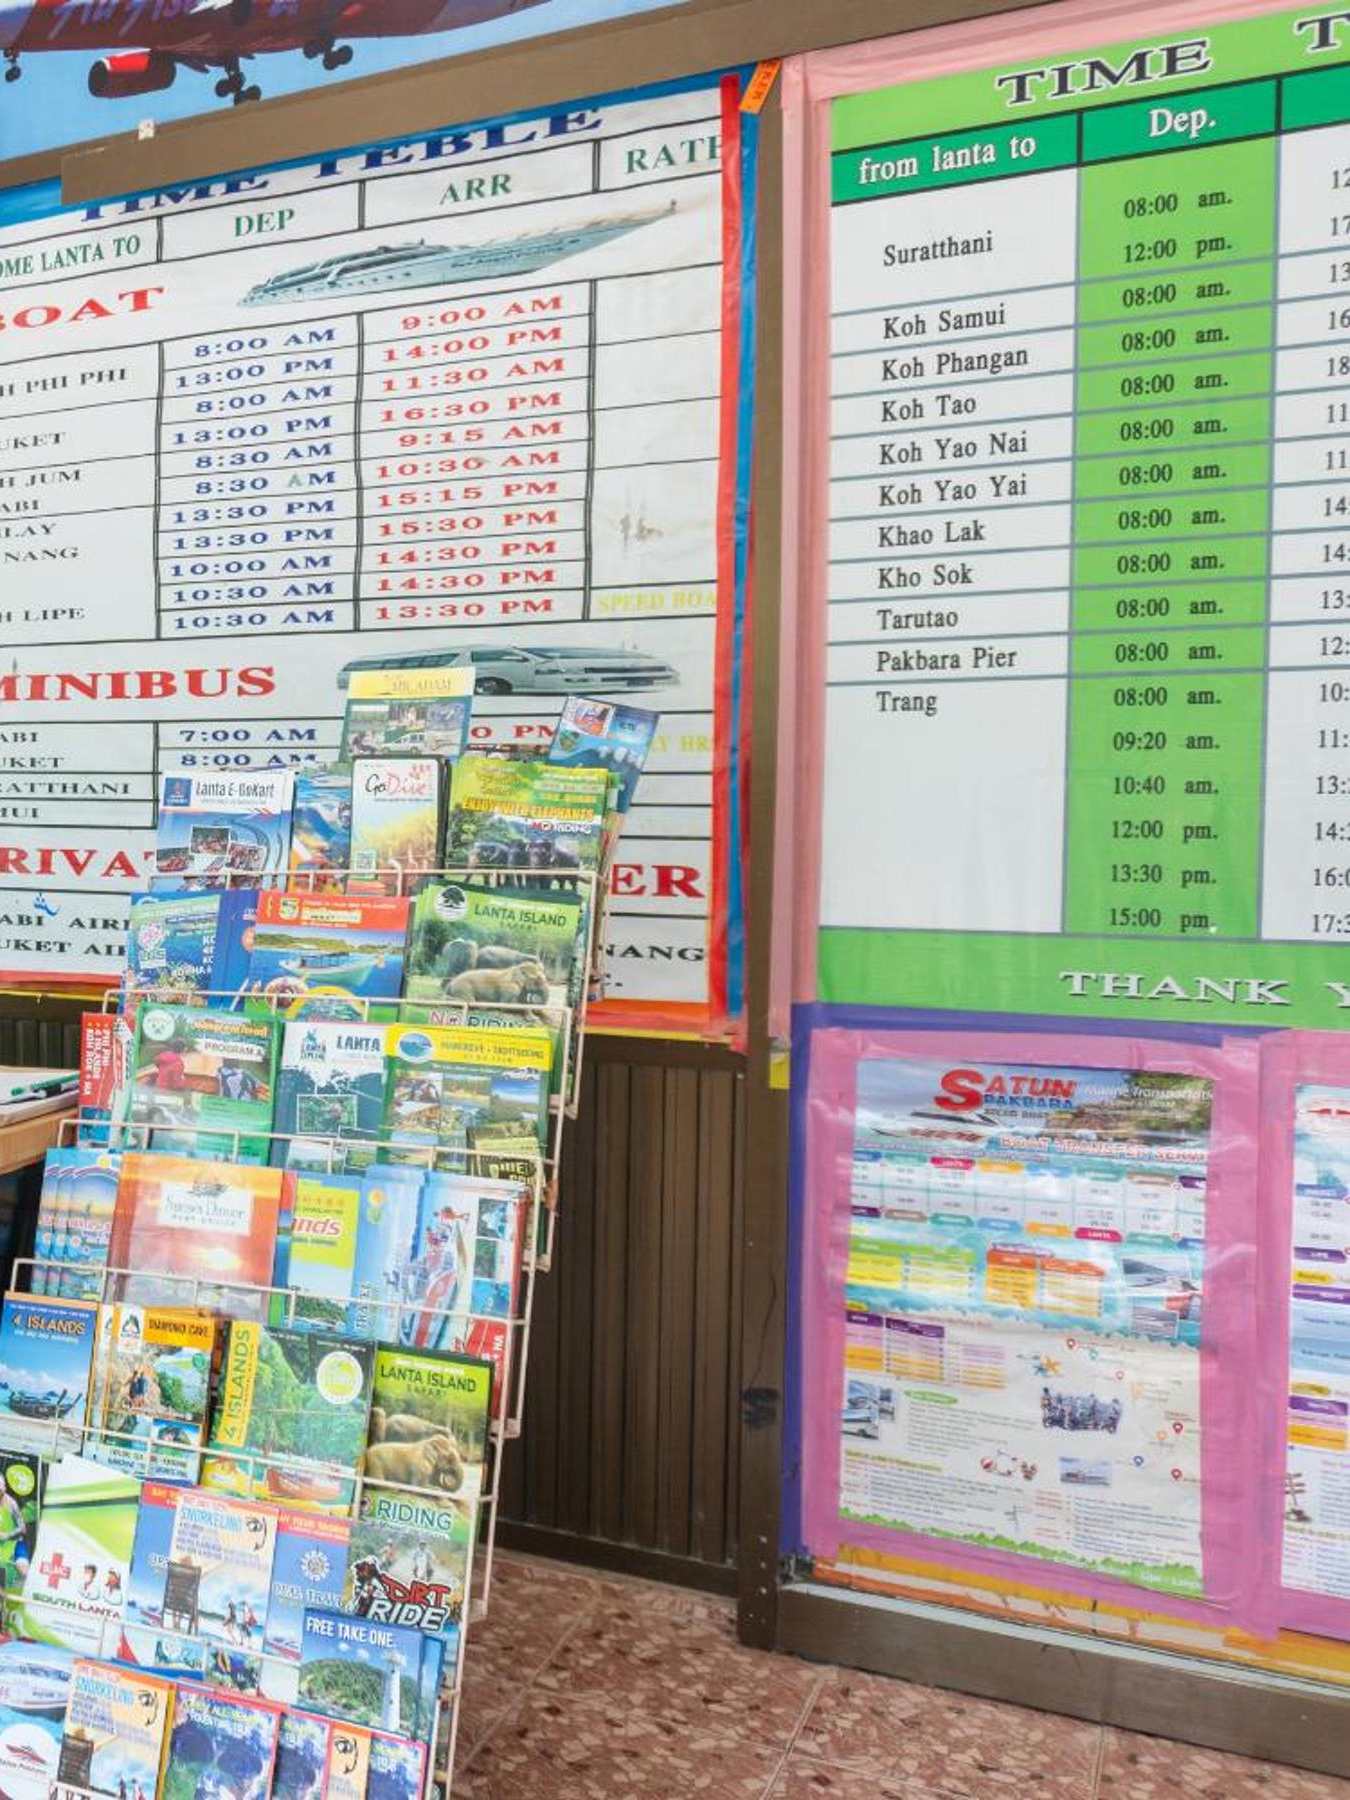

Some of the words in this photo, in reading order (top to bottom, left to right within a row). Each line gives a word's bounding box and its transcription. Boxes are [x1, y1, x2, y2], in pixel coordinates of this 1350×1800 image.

[998, 38, 1211, 105] TIME
[1149, 107, 1215, 138] Dep.
[859, 158, 918, 184] from
[932, 144, 996, 174] lanta
[1010, 136, 1036, 160] to
[439, 173, 513, 205] ARR
[1124, 193, 1178, 218] 08:00
[1198, 192, 1233, 208] am.
[233, 207, 296, 238] DEP
[41, 241, 106, 275] LANTA
[113, 233, 141, 259] TO
[883, 231, 993, 266] Suratthani
[1124, 240, 1177, 263] 12:00
[1196, 238, 1233, 260] pm.
[401, 307, 486, 332] 9:00
[503, 295, 564, 318] AM
[883, 316, 927, 339] Koh
[939, 304, 1007, 332] Samui
[195, 335, 268, 360] 8:00
[284, 327, 337, 346] AM
[382, 337, 489, 364] 14:00
[507, 327, 563, 346] PM
[175, 363, 266, 388] 13:00
[284, 355, 335, 374] PM
[380, 369, 489, 393] 11:30
[503, 358, 564, 378] AM
[882, 357, 924, 381] Koh
[937, 347, 1028, 377] Phangan
[26, 376, 67, 393] PHI
[80, 368, 127, 385] PHI
[881, 401, 924, 422] Koh
[938, 397, 977, 415] Tao
[400, 427, 486, 449] 9:15
[503, 421, 563, 440] AM
[1120, 418, 1174, 441] 08:00
[1193, 417, 1228, 434] am.
[195, 448, 268, 470] 8:30
[284, 442, 335, 462] AM
[880, 442, 922, 465] Koh
[935, 438, 977, 459] Yao
[989, 432, 1028, 453] Nai
[26, 470, 81, 487] JUM
[879, 484, 921, 506] Koh
[935, 480, 977, 501] Yao
[990, 474, 1027, 496] Yai
[377, 486, 484, 508] 15:15
[505, 478, 558, 498] PM
[878, 526, 933, 547] Khao
[945, 520, 985, 542] Lak
[4, 547, 79, 562] NANG
[170, 558, 266, 579] 10:00
[282, 553, 334, 572] AM
[878, 566, 920, 588] Kho
[933, 563, 973, 585] Sok
[24, 608, 85, 621] LIPE
[877, 609, 958, 630] Tarutao
[877, 649, 961, 672] Pakbara
[972, 647, 1017, 669] Pier
[877, 691, 938, 715] Trang
[180, 727, 253, 743] 7:00
[266, 726, 318, 742] AM
[1113, 731, 1166, 752] 09:20
[1185, 733, 1220, 750] am.
[181, 752, 252, 768] 8:00
[1112, 820, 1163, 840] 12:00
[1182, 823, 1218, 843] pm.
[474, 904, 516, 922] LANTA
[519, 911, 568, 928] ISLAND
[1110, 908, 1161, 928] 15:00
[1059, 971, 1291, 1006] THANK
[934, 1069, 1077, 1113] SATUN
[233, 1328, 250, 1419] ISLANDS
[381, 1364, 424, 1384] LANTA
[427, 1372, 476, 1393] ISLAND
[377, 1499, 452, 1530] RIDING
[368, 1600, 449, 1631] RIDE
[306, 1617, 336, 1636] FREE
[338, 1624, 368, 1643] TAKE
